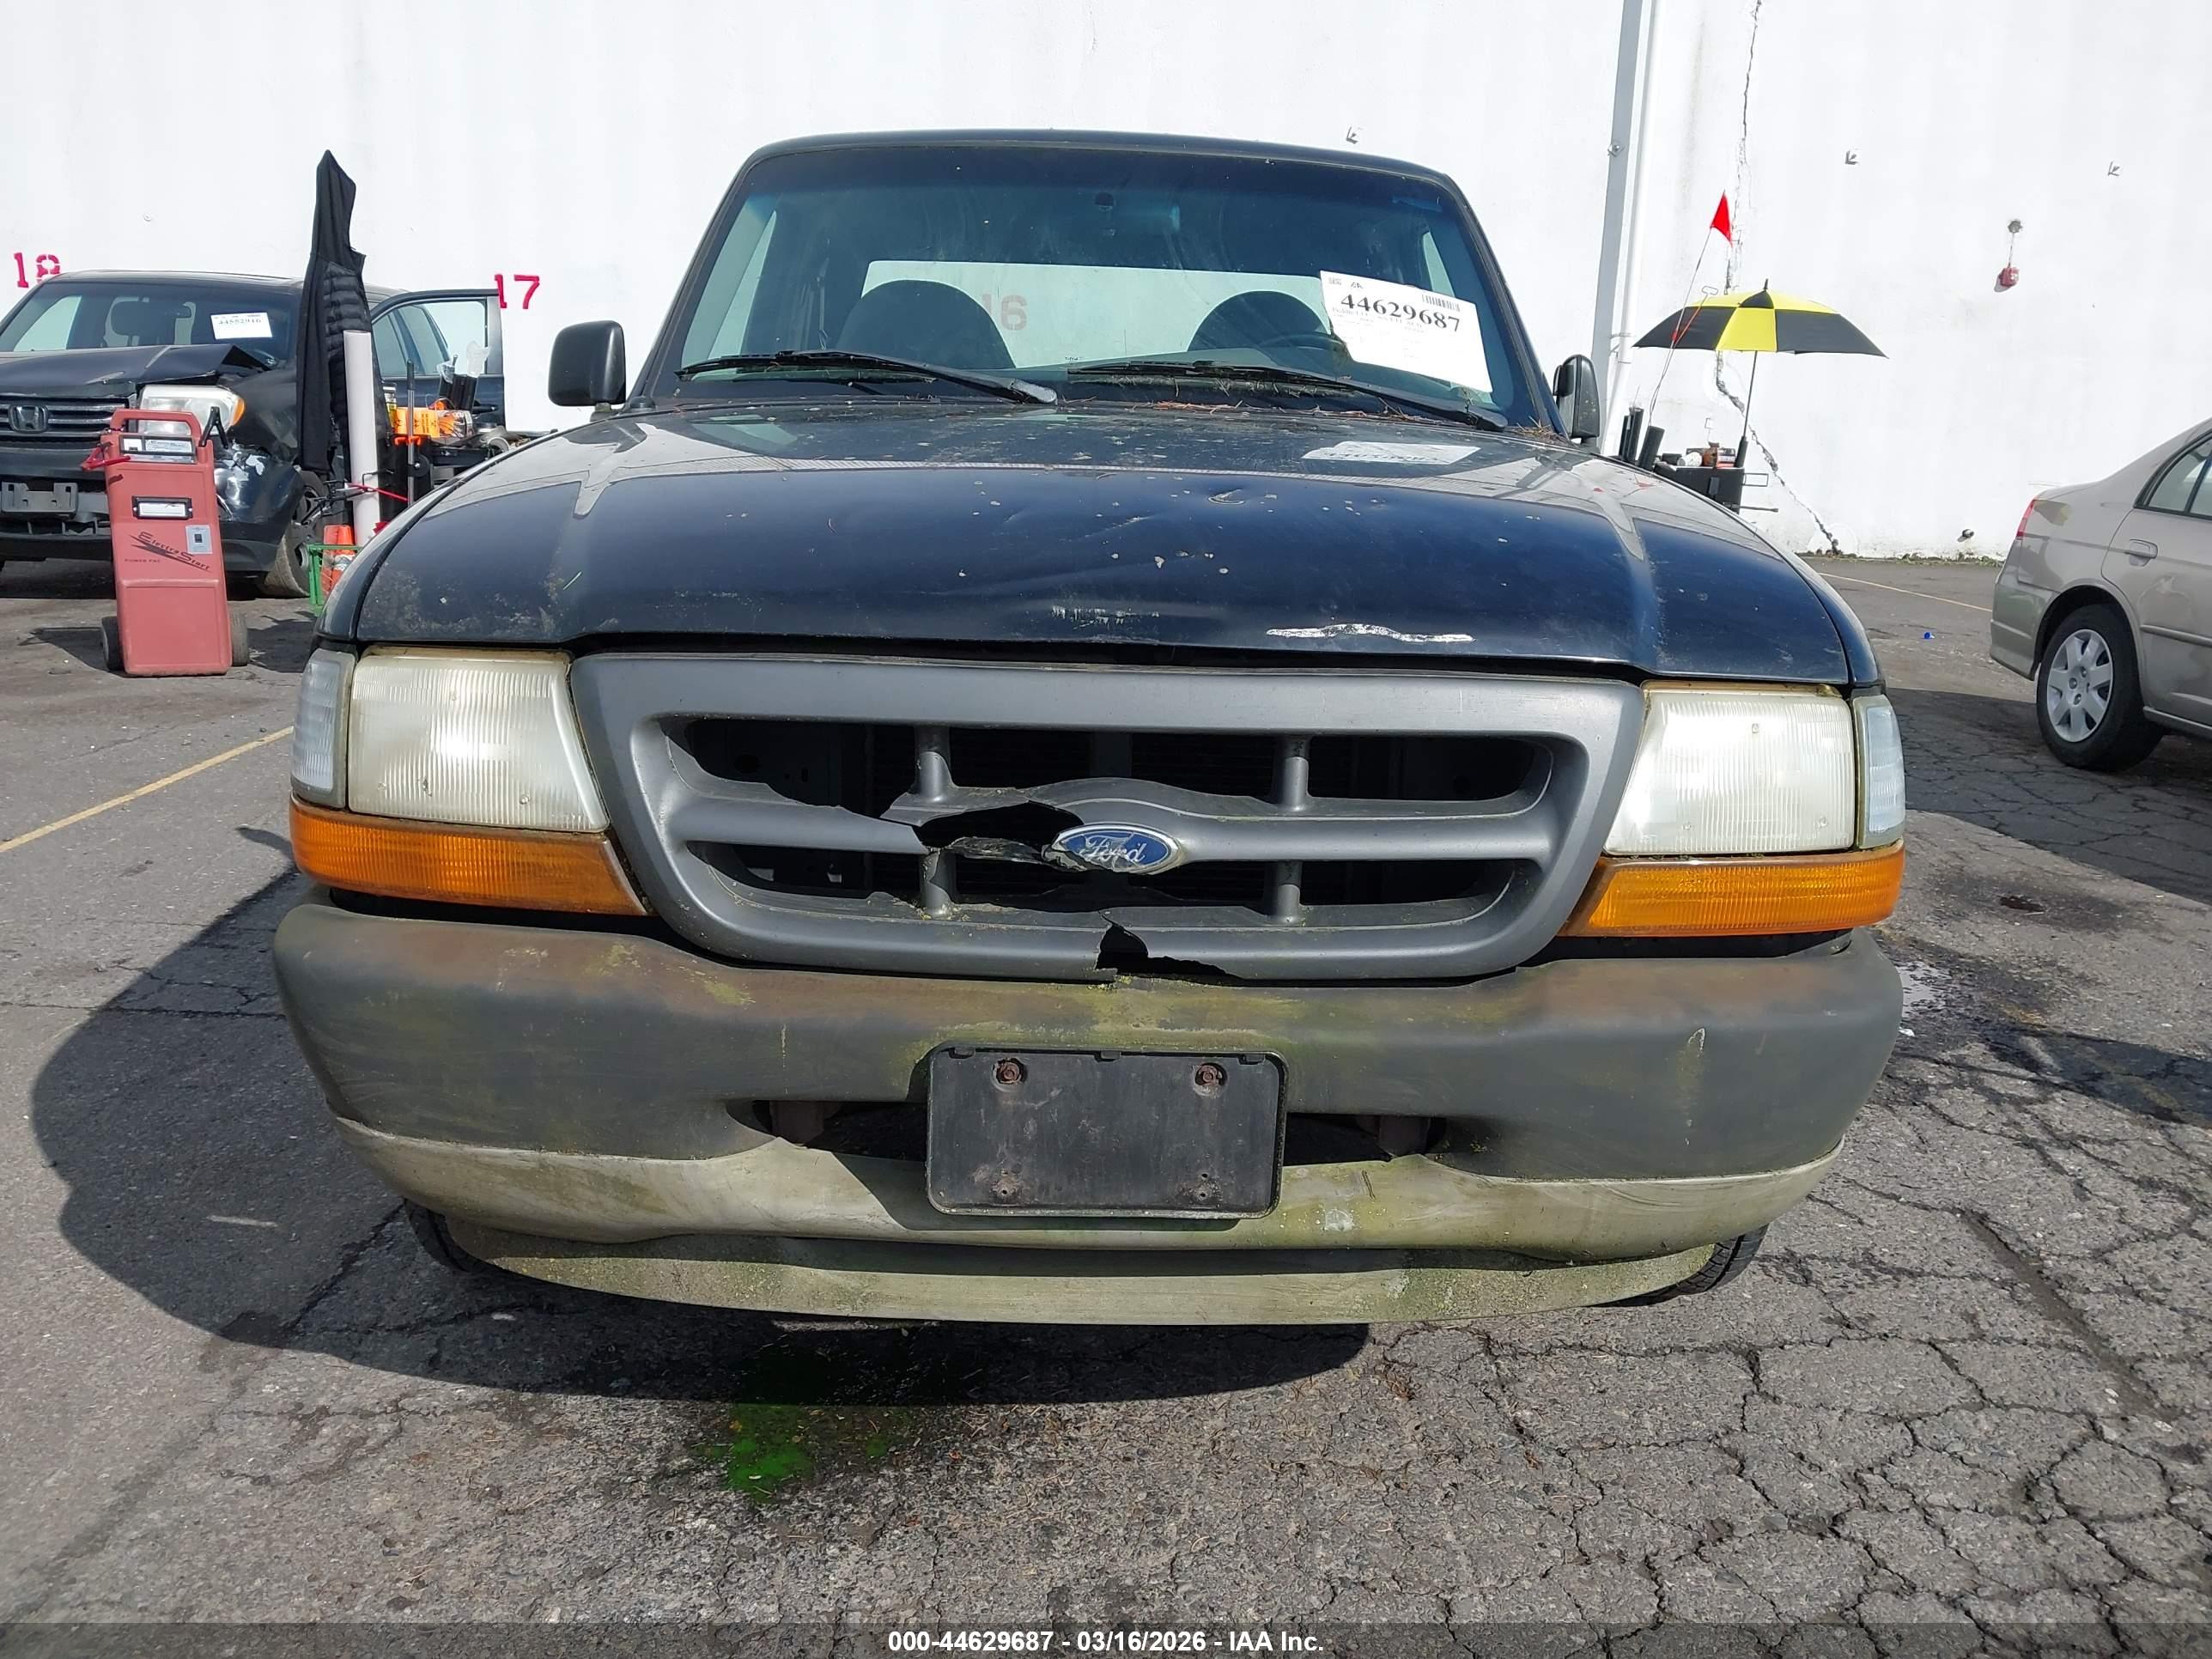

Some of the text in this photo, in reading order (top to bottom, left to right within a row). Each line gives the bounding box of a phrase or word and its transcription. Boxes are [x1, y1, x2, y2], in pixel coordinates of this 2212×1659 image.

[14, 252, 61, 289] 18
[494, 273, 540, 310] 17
[981, 293, 1028, 331] 16
[1340, 293, 1461, 332] 44629687
[1079, 833, 1148, 864] Ford
